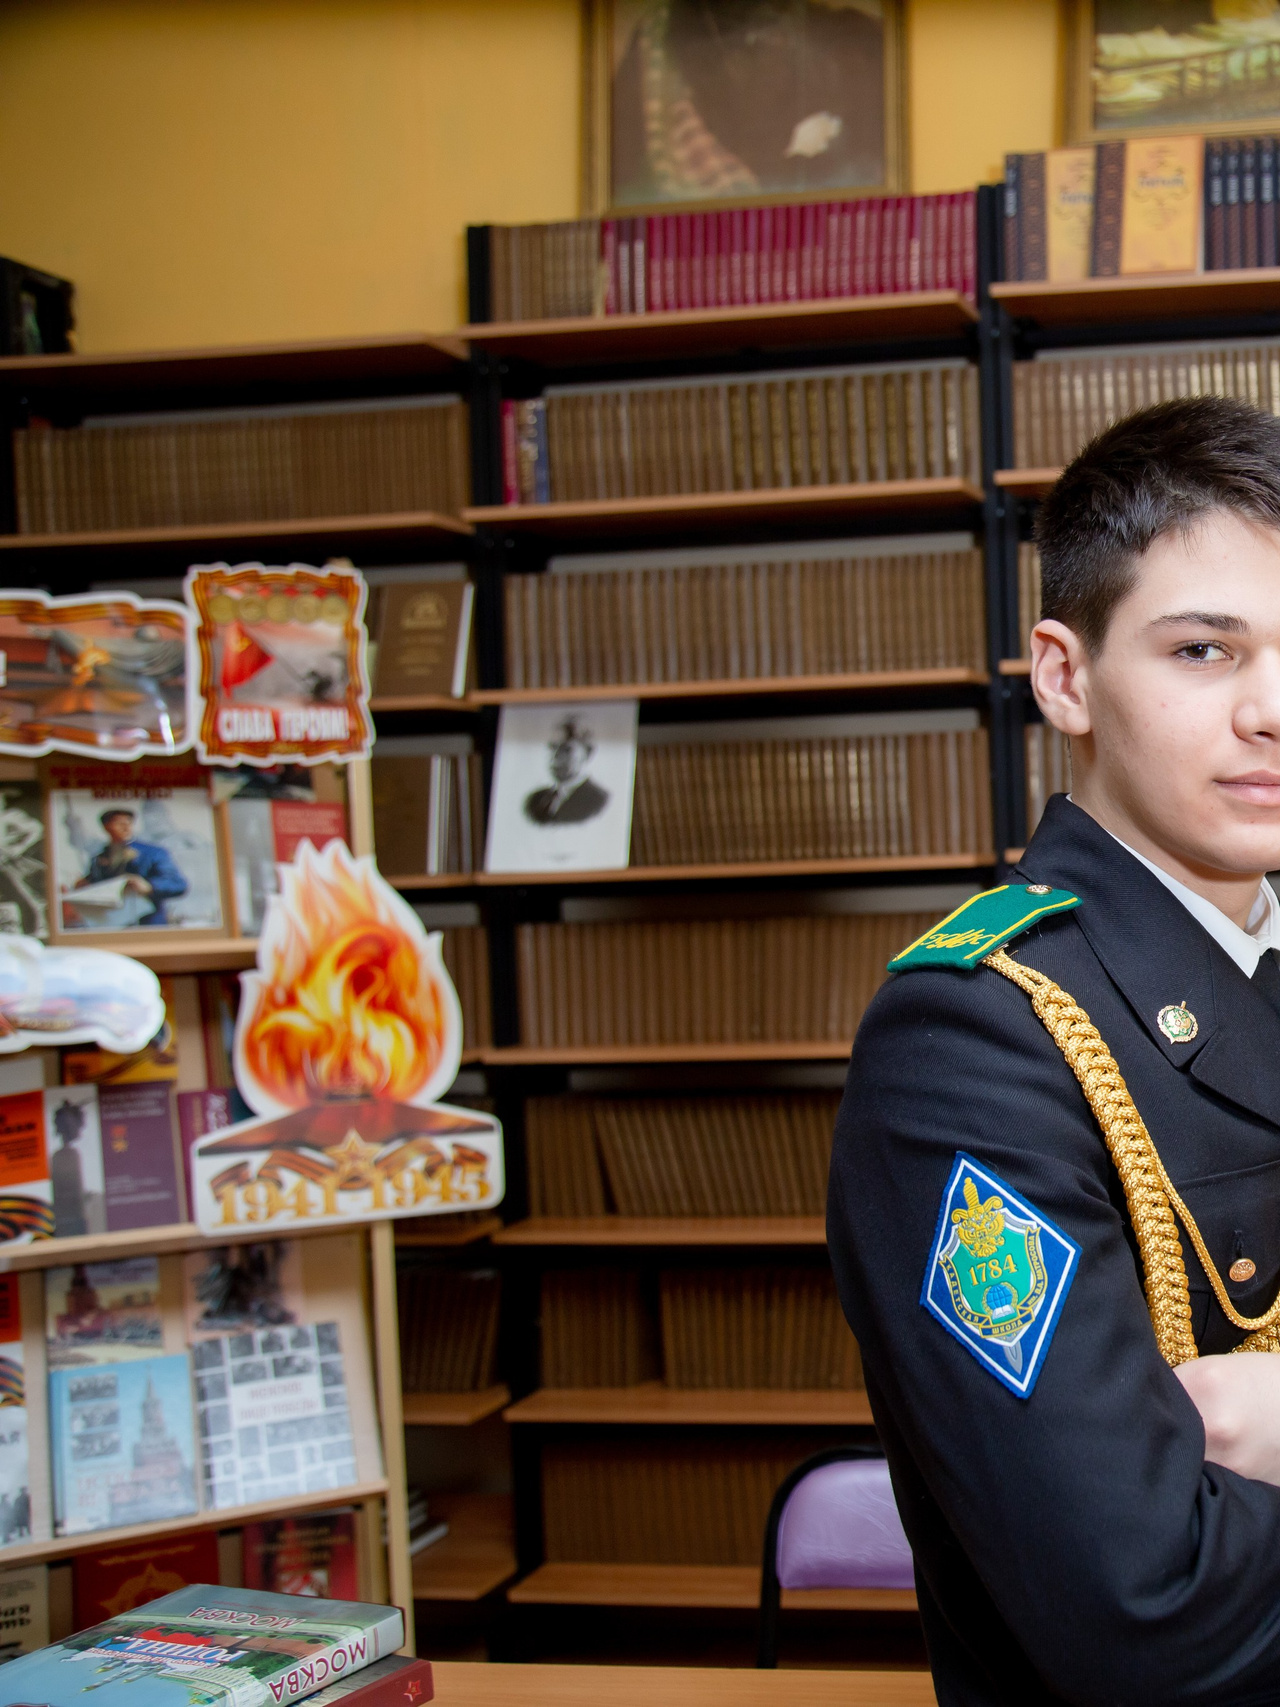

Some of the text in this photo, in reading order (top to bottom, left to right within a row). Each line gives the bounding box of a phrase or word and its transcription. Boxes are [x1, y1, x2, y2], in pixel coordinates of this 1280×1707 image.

[220, 705, 349, 743] СЛАВА ГЕРОЯМ!
[968, 1253, 1018, 1287] 1784
[1028, 1235, 1044, 1281] МАТРОСОВА
[946, 1264, 979, 1323] КАДЕТСКАЯ
[991, 1319, 1023, 1336] ШКОЛА
[186, 1605, 307, 1631] МОСКВА
[114, 1635, 250, 1664] РОДИНА...
[267, 1634, 368, 1704] МОСКВА
